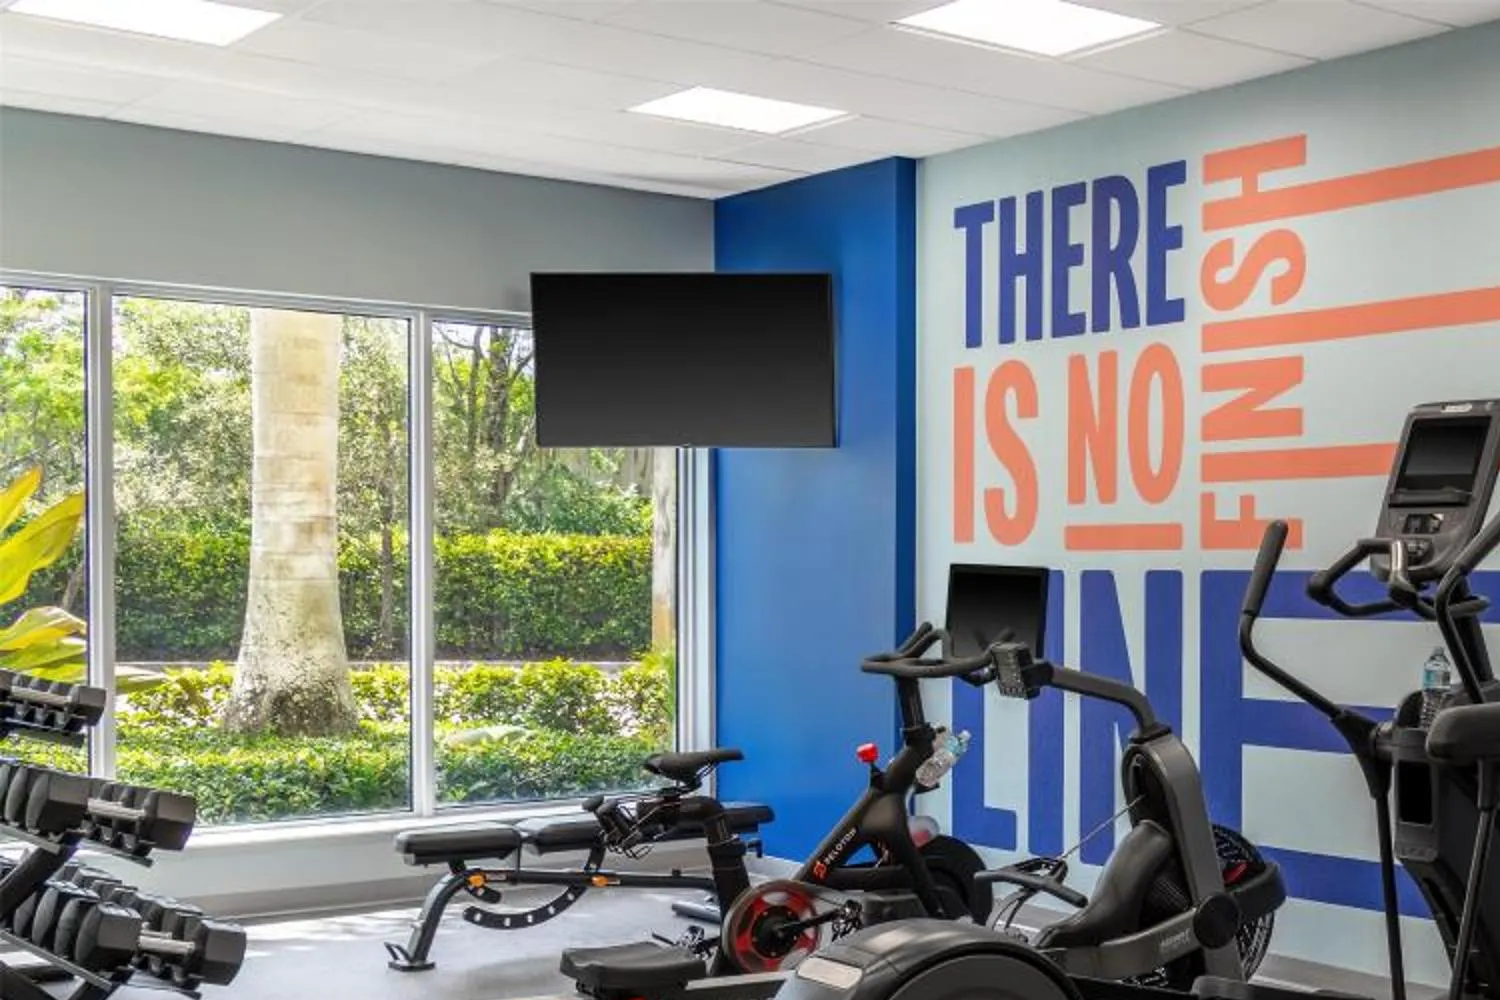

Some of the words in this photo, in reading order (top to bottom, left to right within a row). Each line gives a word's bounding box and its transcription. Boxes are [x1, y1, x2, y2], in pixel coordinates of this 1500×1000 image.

[953, 159, 1187, 349] THERE
[1200, 134, 1307, 551] FINISH
[953, 359, 1039, 546] IS
[1067, 342, 1185, 505] NO
